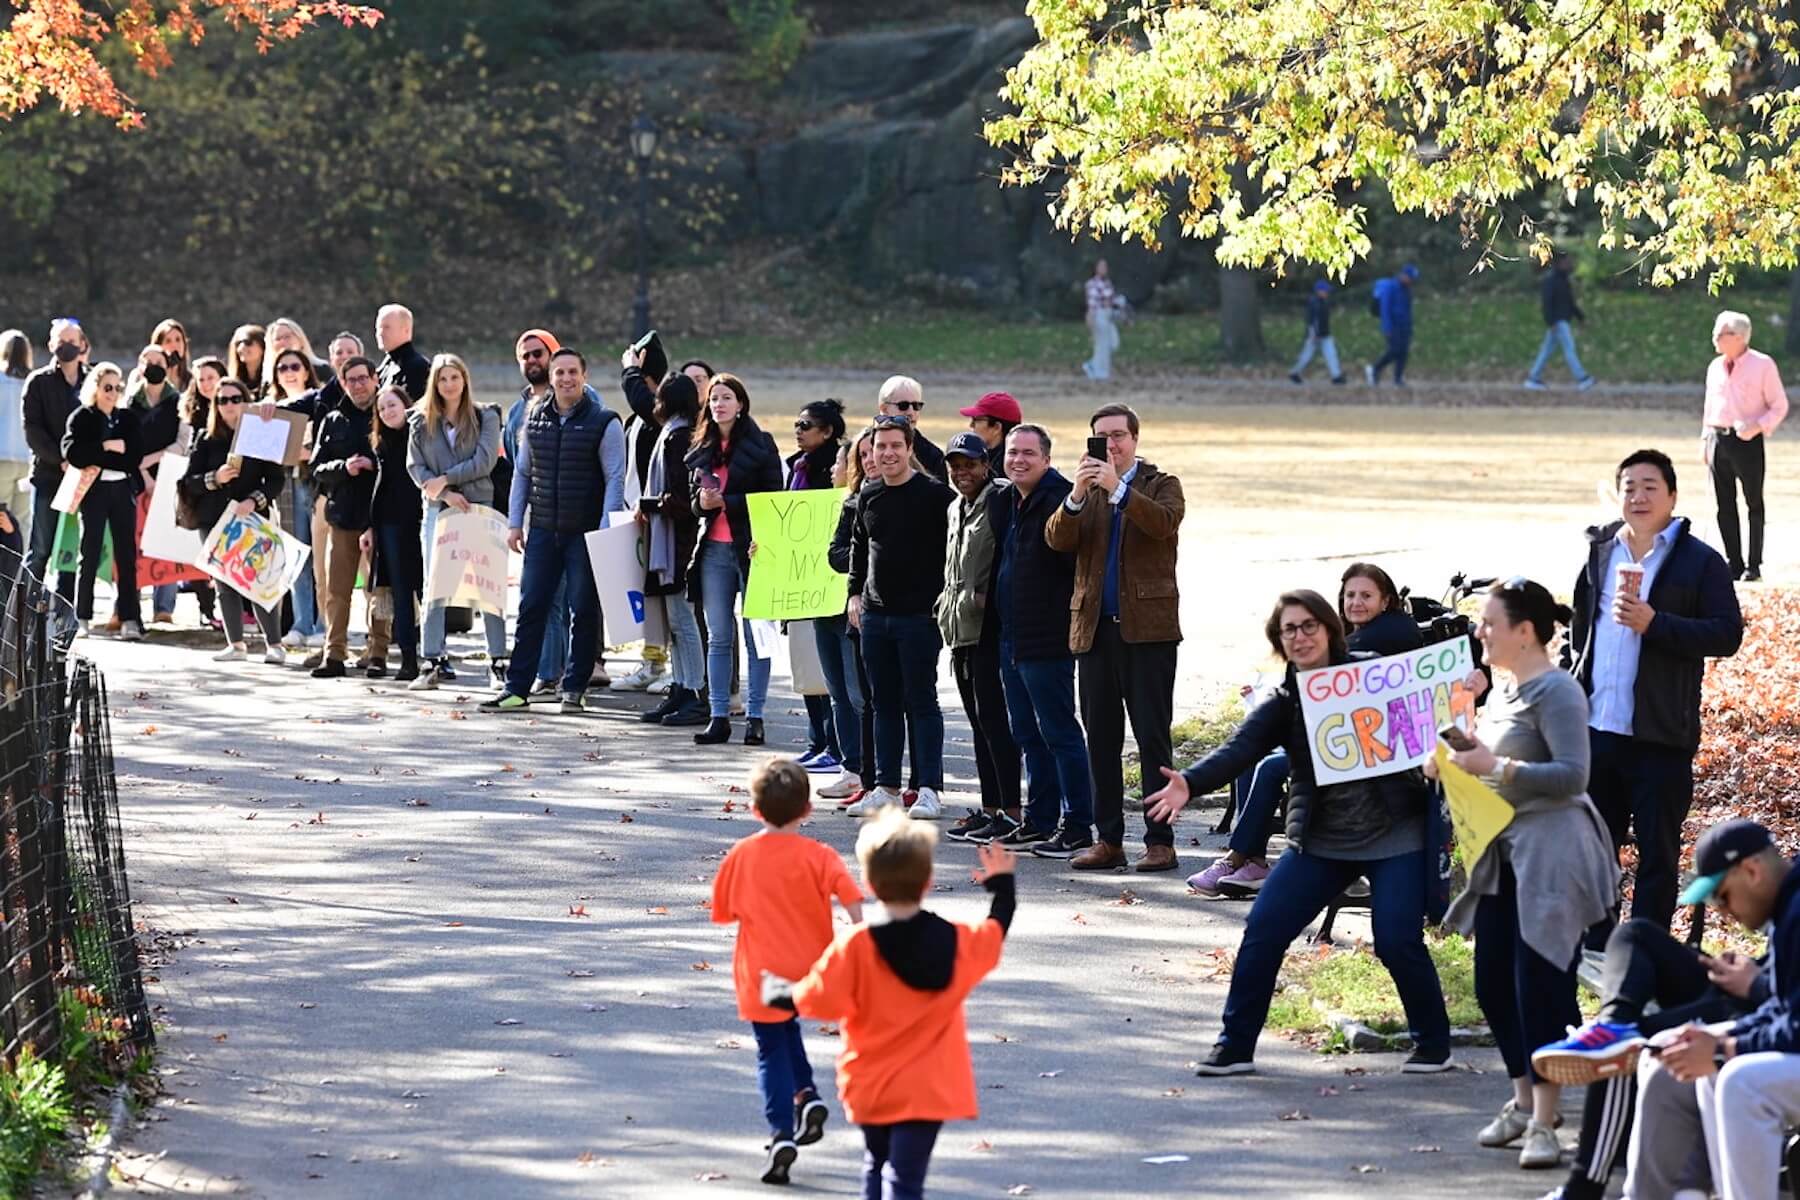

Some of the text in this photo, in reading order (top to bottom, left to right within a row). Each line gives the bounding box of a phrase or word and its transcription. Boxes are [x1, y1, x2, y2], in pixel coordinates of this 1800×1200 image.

[789, 549, 822, 581] MY
[771, 586, 826, 616] HERO!
[1306, 639, 1465, 703] GO! GO! GO!
[1315, 678, 1476, 771] GRAHAM
